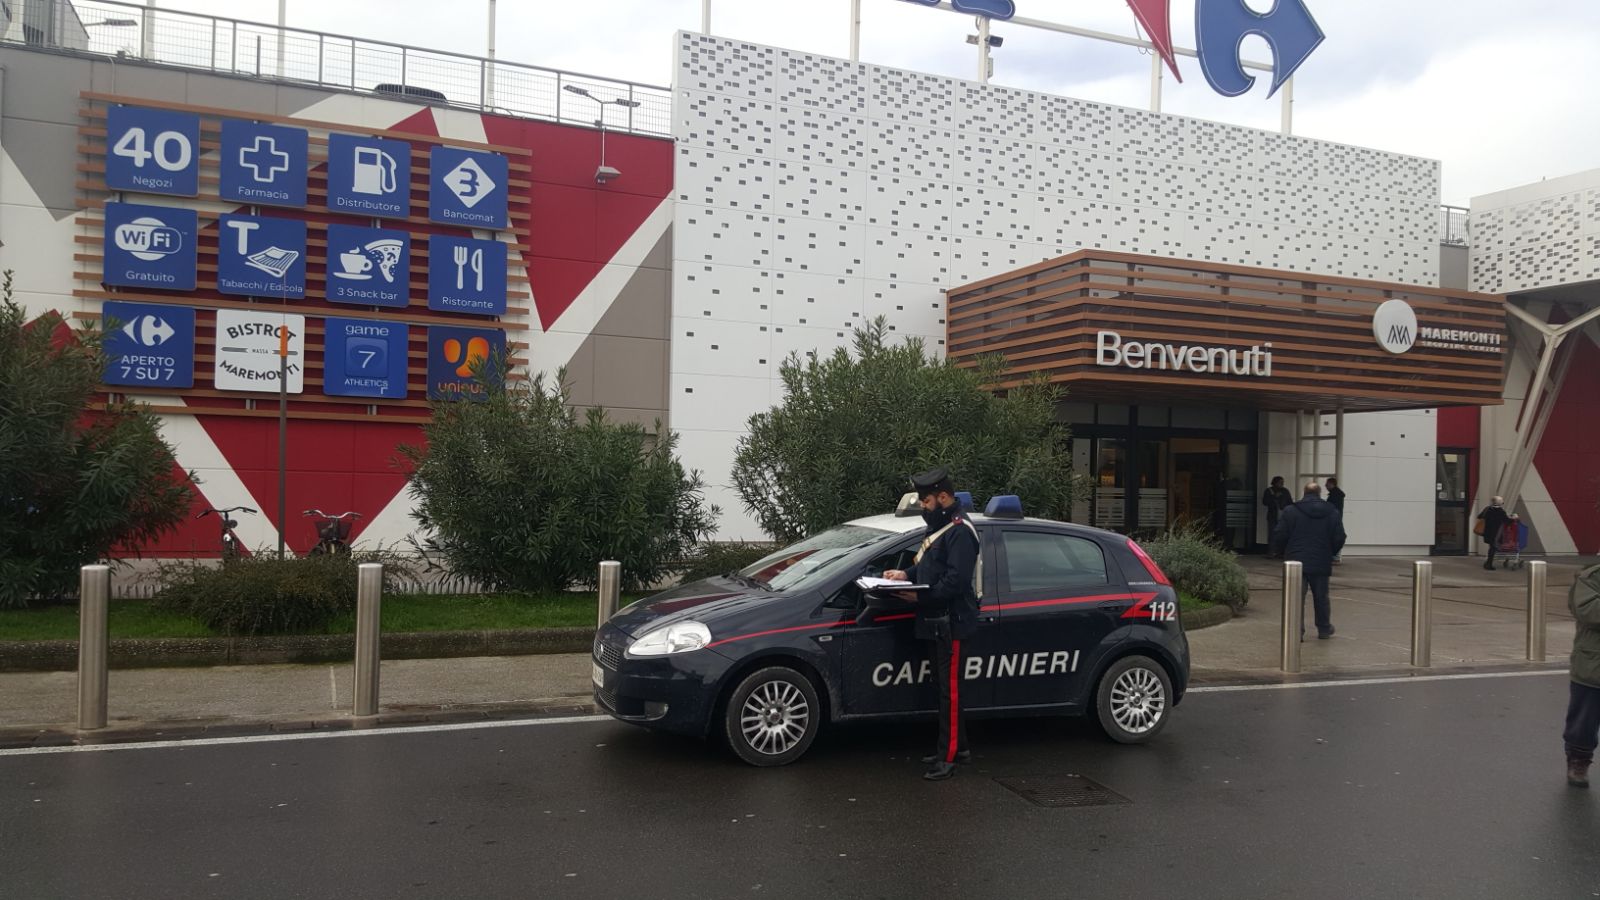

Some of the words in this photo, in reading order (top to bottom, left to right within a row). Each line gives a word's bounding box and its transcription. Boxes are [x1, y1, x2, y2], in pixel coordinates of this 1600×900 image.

[113, 127, 192, 172] 40
[132, 175, 173, 188] Negozi
[238, 186, 289, 200] Farmacia
[337, 197, 401, 212] Distributore
[443, 209, 495, 223] Bancomat
[226, 220, 260, 256] T
[125, 270, 175, 283] Gratuito
[221, 279, 263, 290] Tabacchi
[269, 282, 303, 293] Edicola
[337, 287, 345, 296] 3
[347, 288, 378, 299] Snack
[380, 290, 399, 301] bar
[442, 297, 494, 309] Ristorante
[345, 324, 390, 337] game
[1420, 327, 1501, 345] MAREMONTI
[358, 350, 377, 369] 7
[1096, 330, 1272, 377] Benvenuti
[121, 355, 175, 367] APERTO
[121, 367, 131, 379] 7
[135, 368, 160, 380] SU
[165, 370, 175, 381] 7
[344, 378, 389, 388] ATHLETICS
[1149, 601, 1176, 622] 112
[872, 649, 1081, 687] CARBINIERI
